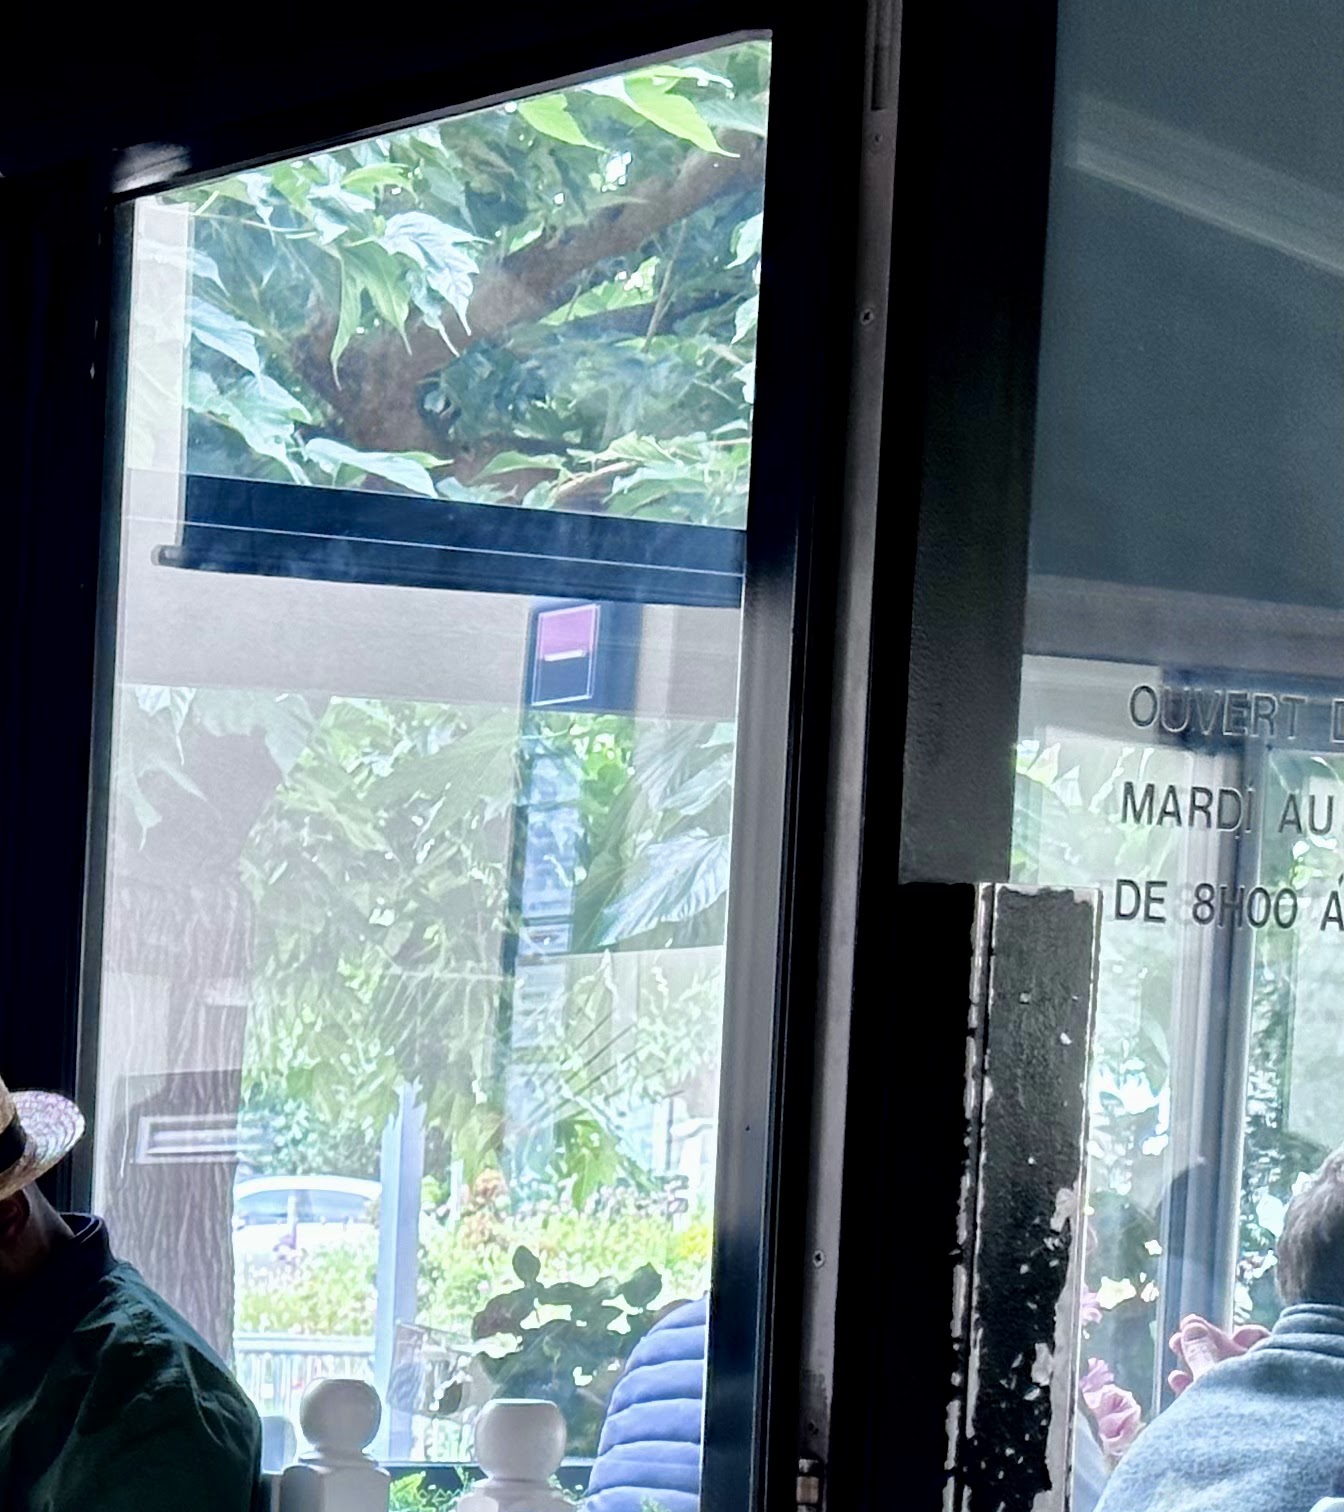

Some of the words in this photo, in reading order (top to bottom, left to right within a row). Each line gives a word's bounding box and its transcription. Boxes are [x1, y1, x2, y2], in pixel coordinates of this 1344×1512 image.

[1129, 685, 1309, 739] OUVERT
[1121, 781, 1256, 833] MARDI
[1278, 795, 1334, 836] AU
[1115, 879, 1167, 923] DE
[1192, 883, 1298, 929] 8H00
